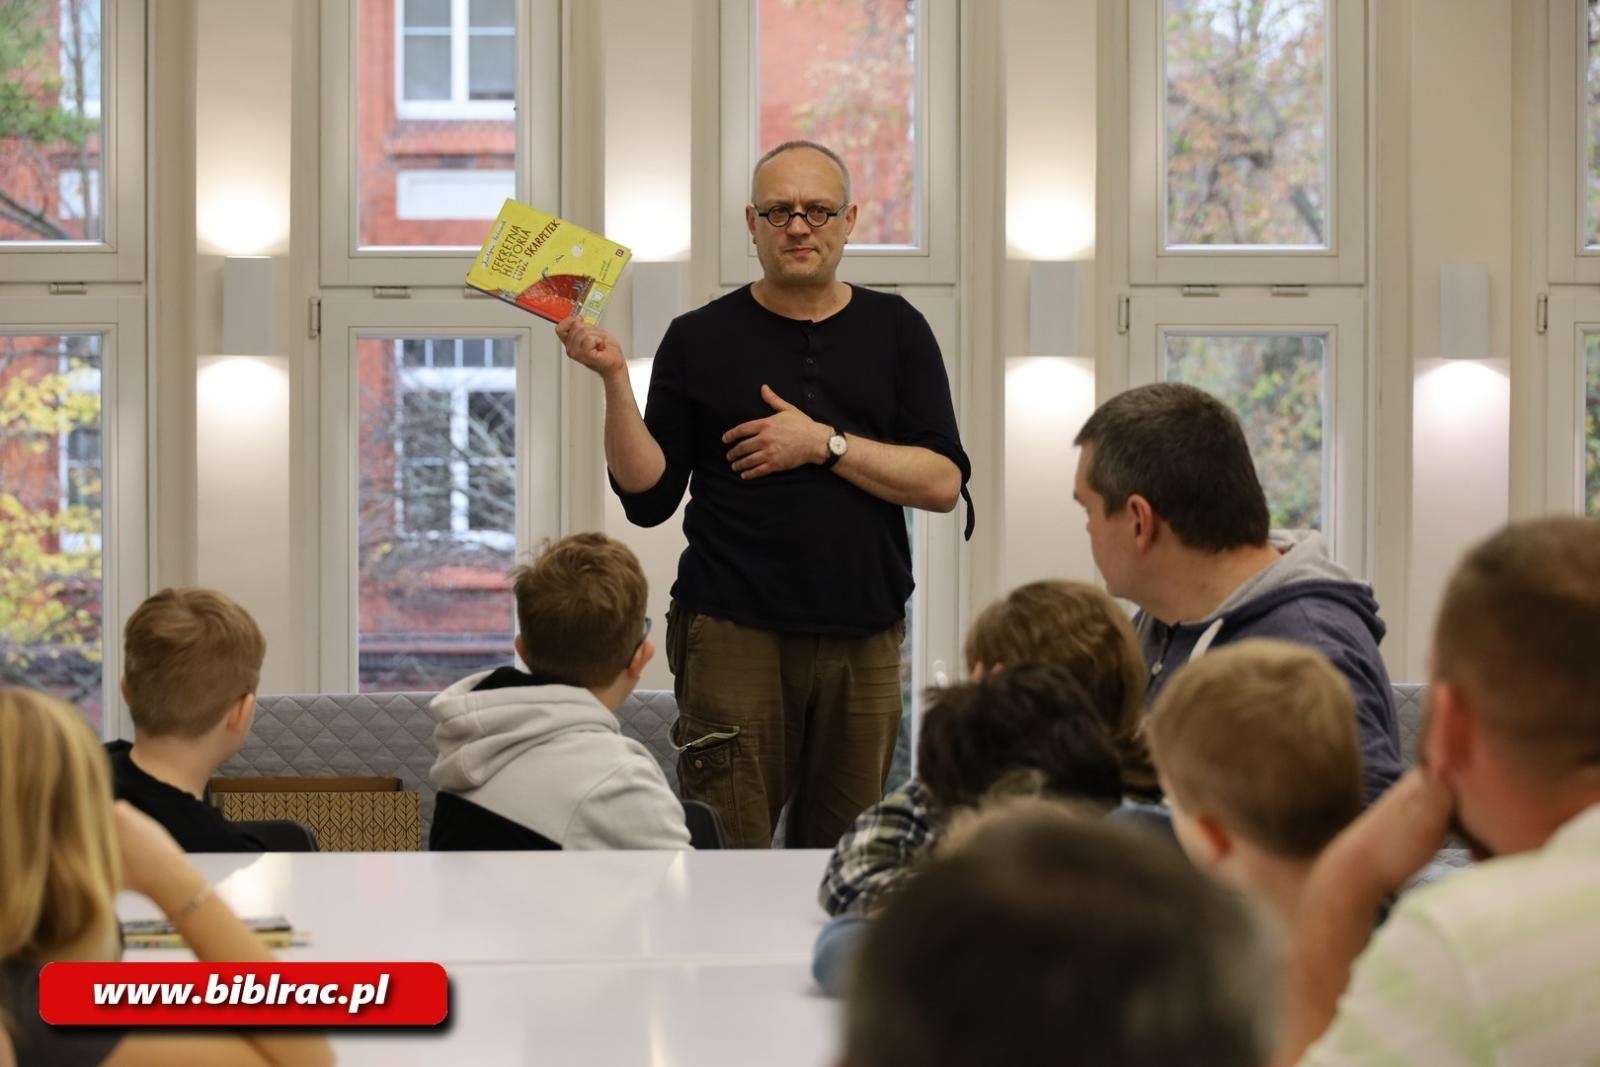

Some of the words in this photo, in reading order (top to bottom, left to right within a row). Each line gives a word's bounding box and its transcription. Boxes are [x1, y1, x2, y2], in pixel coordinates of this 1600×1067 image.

[491, 225, 522, 273] SEKRETNA
[499, 229, 532, 277] HISTORIA
[525, 219, 561, 258] SKARPETEK
